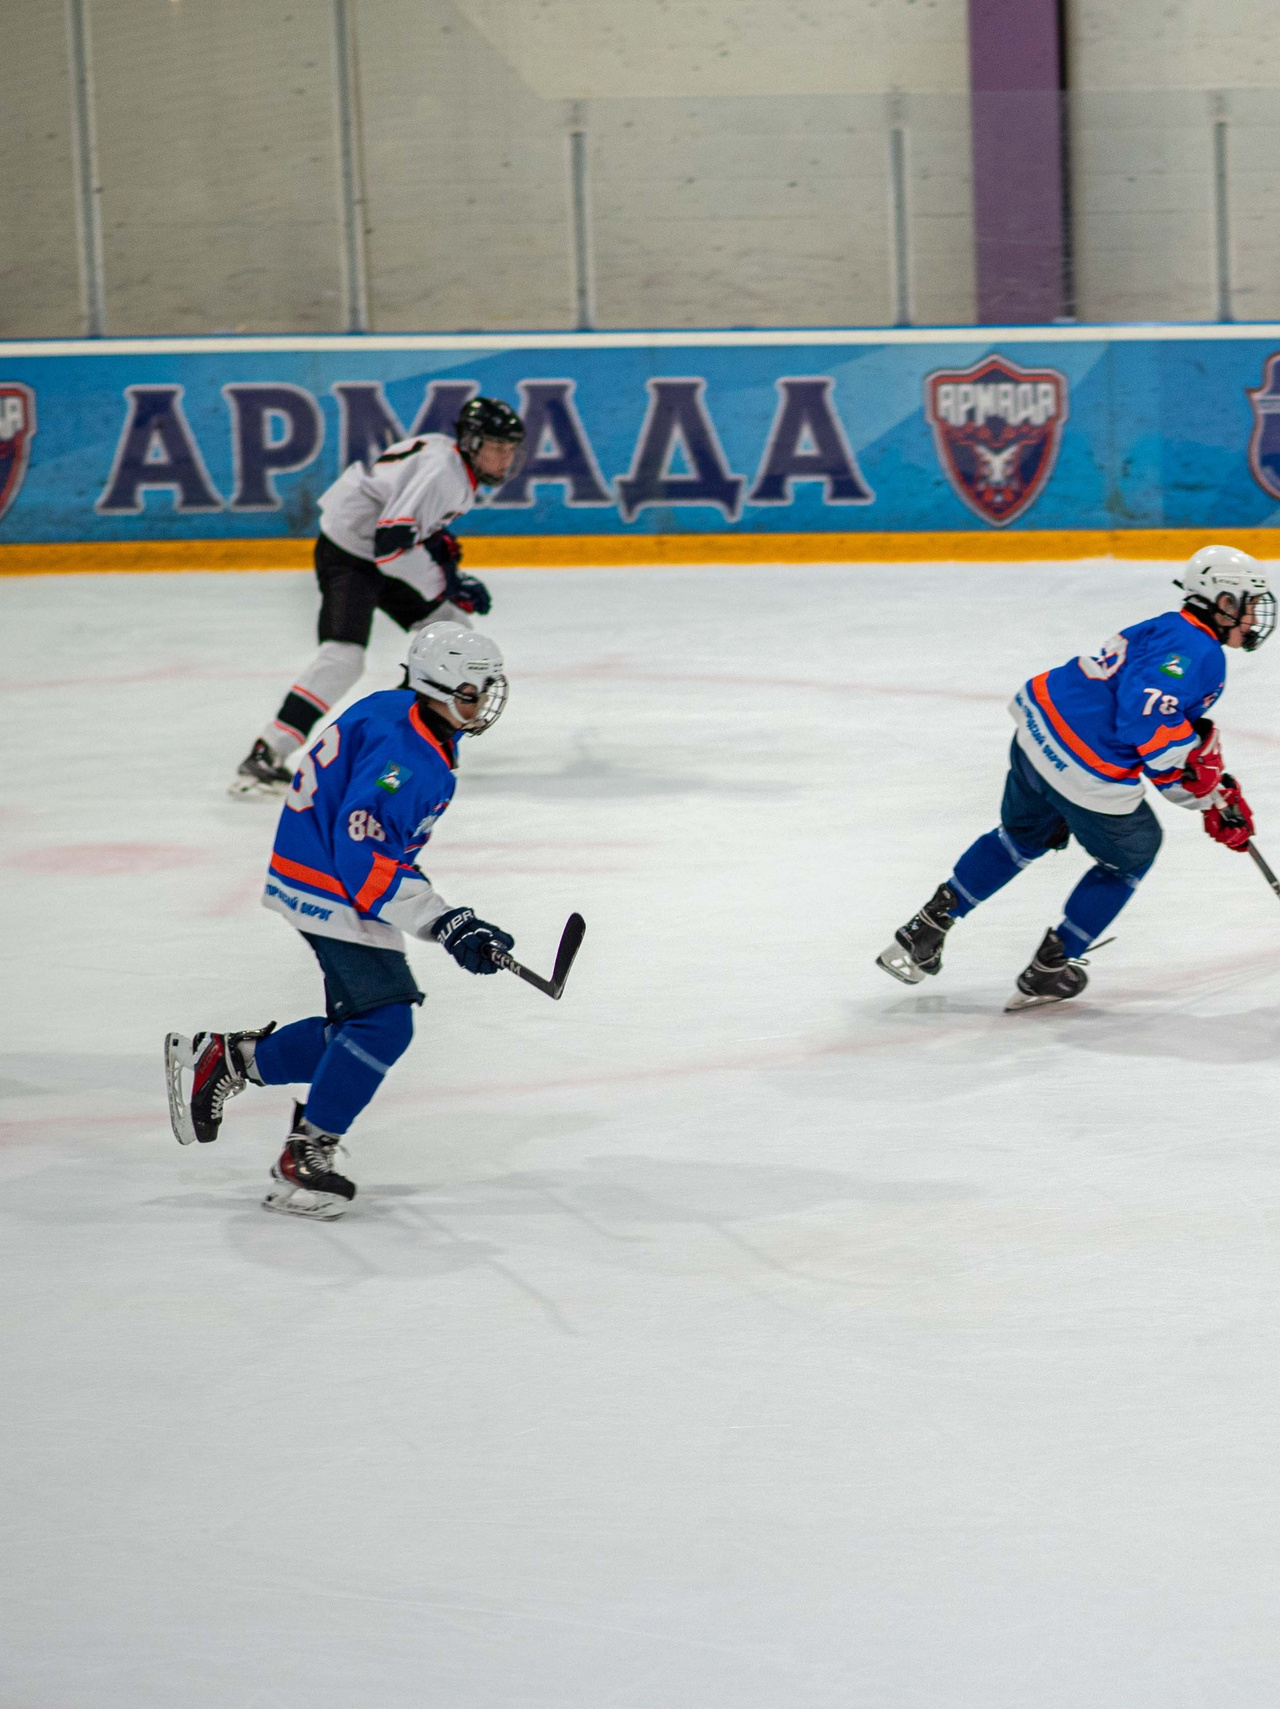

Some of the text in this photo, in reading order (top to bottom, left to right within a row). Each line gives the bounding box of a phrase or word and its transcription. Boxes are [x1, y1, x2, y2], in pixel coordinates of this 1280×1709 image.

[937, 382, 1056, 427] АРМАДА
[1142, 687, 1179, 716] 78
[286, 723, 341, 813] 6
[348, 809, 386, 842] 86
[436, 909, 475, 945] AUER
